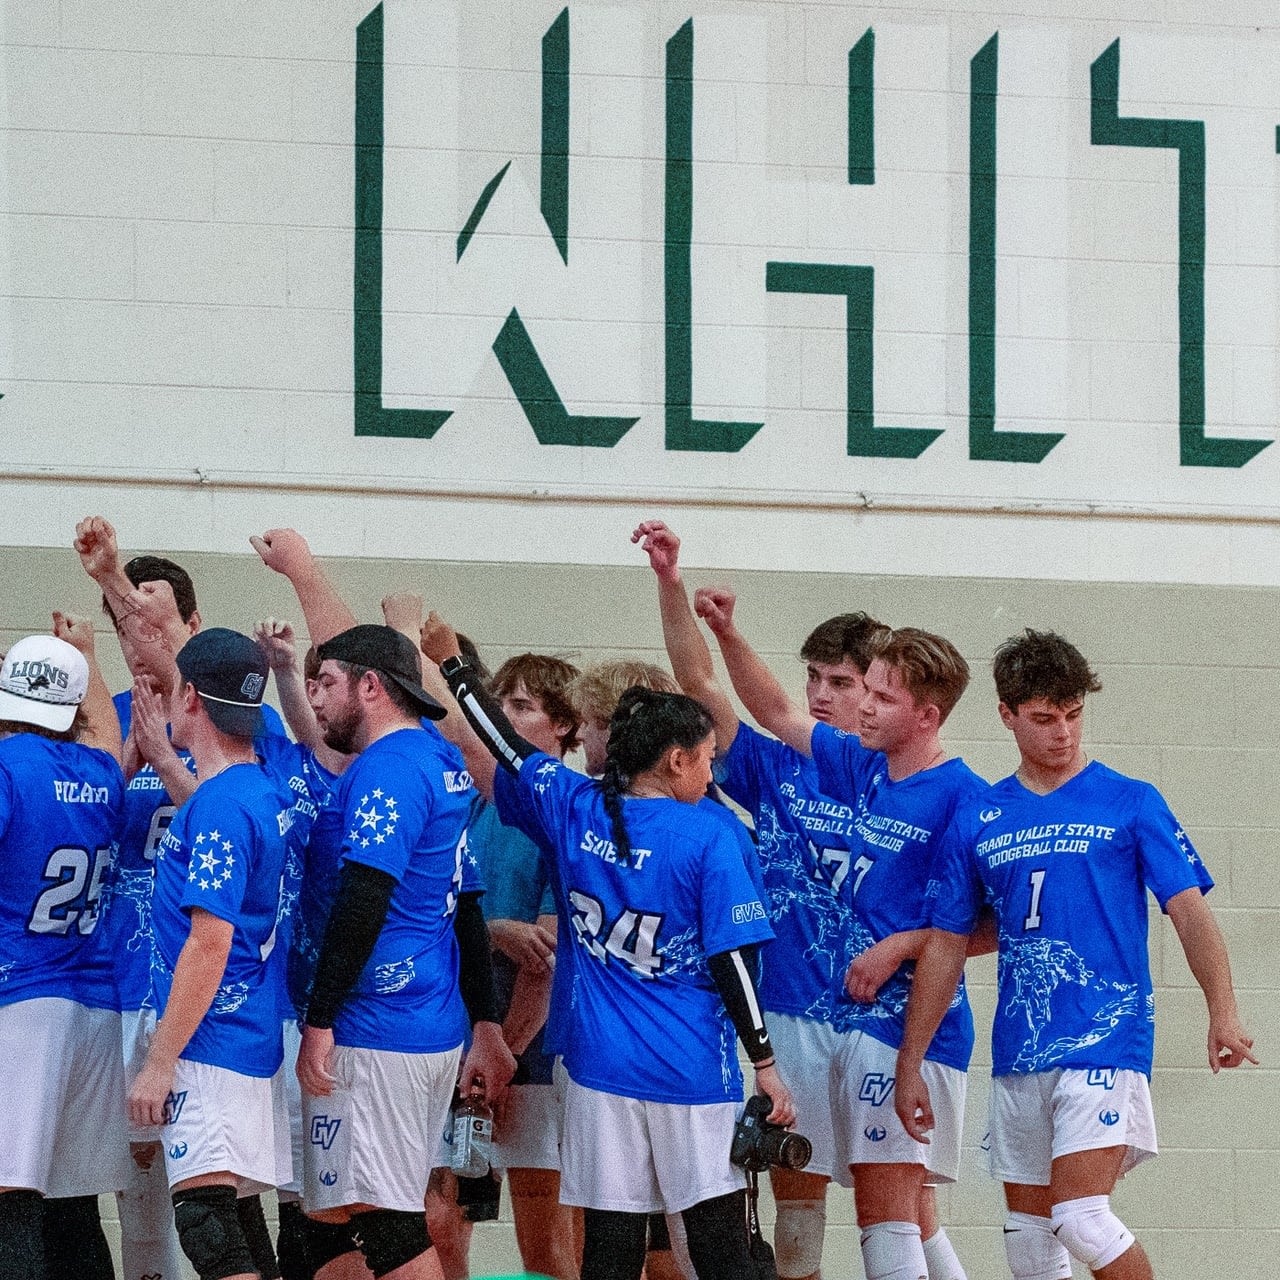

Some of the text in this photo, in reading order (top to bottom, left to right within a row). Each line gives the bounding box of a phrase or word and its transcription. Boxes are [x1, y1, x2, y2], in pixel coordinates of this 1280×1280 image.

[10, 661, 69, 689] LIONS
[890, 820, 932, 843] STATE
[976, 824, 1116, 857] GRAND VALLEY STATE
[988, 839, 1090, 869] DODGEBALL CLUB
[1024, 870, 1046, 930] 1
[570, 890, 662, 979] 24
[859, 1073, 896, 1106] GV
[311, 1115, 342, 1151] GV
[473, 1120, 484, 1131] G
